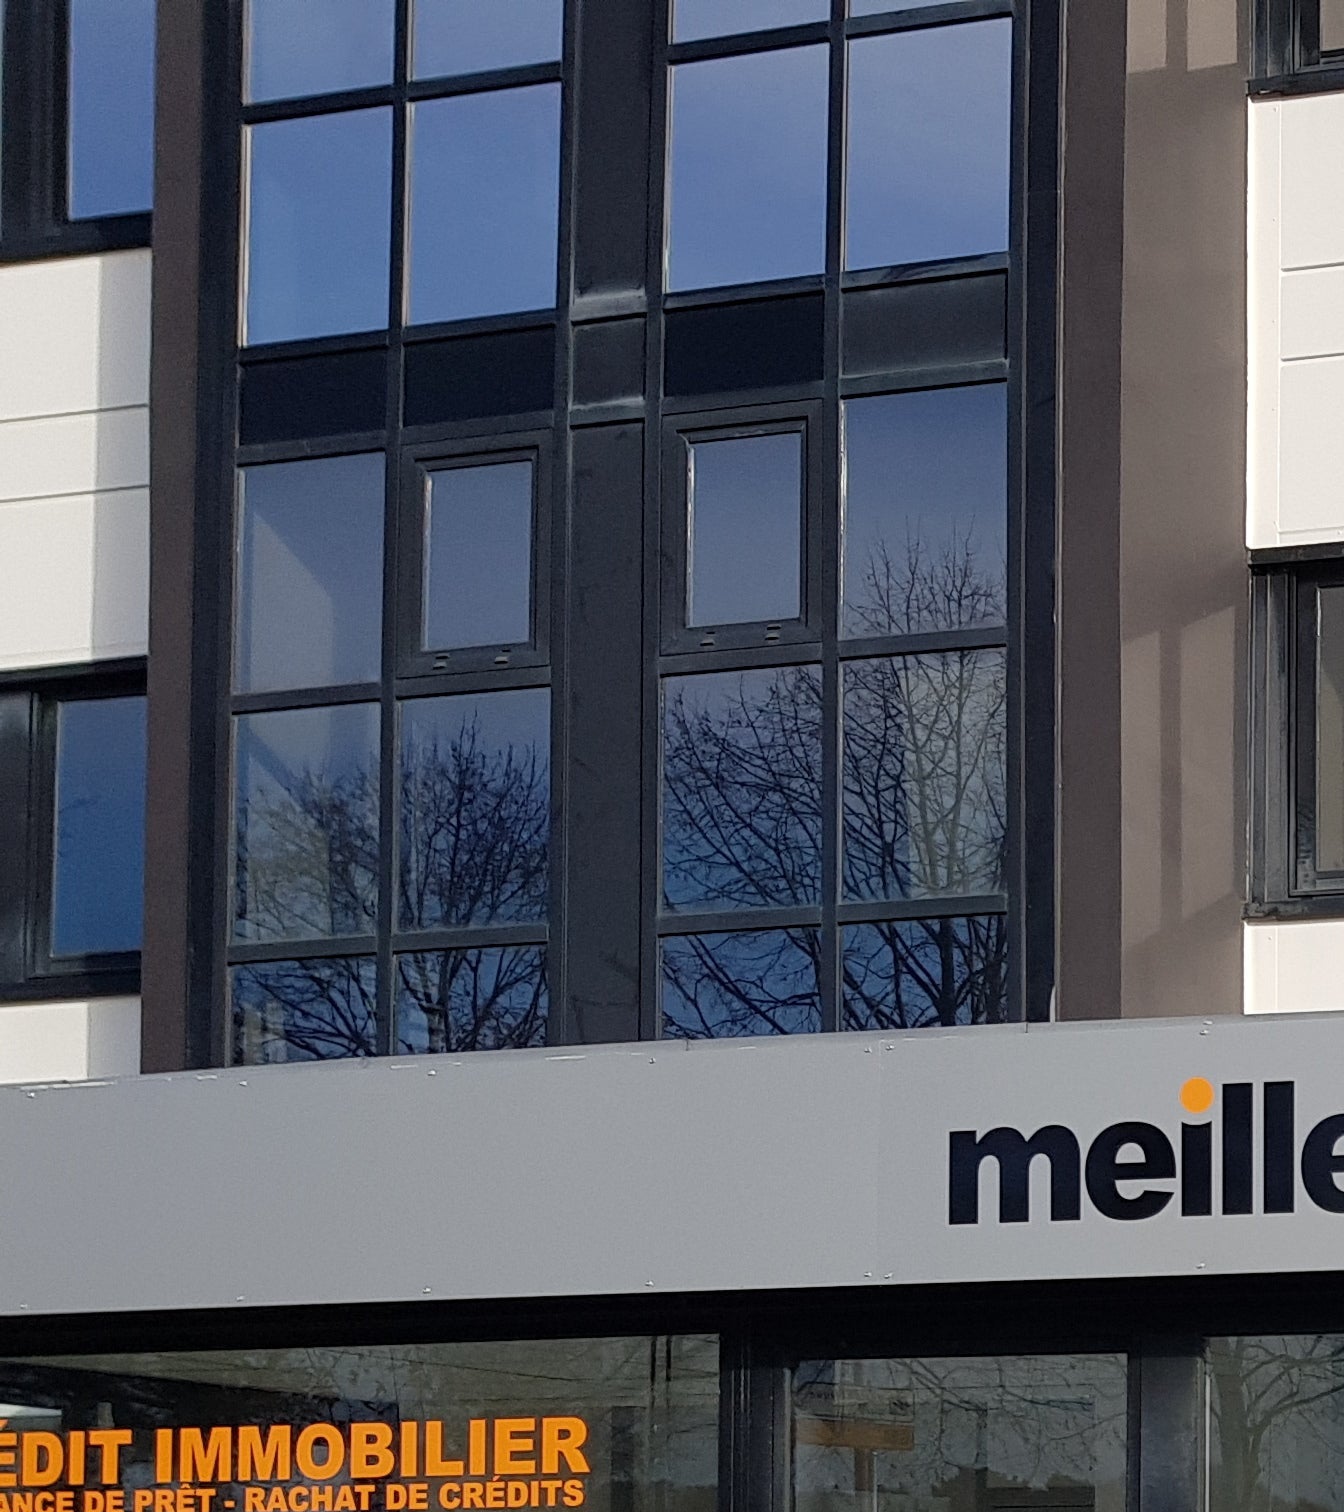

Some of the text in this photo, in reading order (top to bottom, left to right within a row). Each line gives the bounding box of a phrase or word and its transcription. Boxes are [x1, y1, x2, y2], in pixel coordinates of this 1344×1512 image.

[154, 1416, 590, 1484] IMMOBILIER
[245, 1484, 374, 1512] RACHAT
[386, 1483, 428, 1511] DE
[439, 1475, 586, 1510] CRÉDITS
